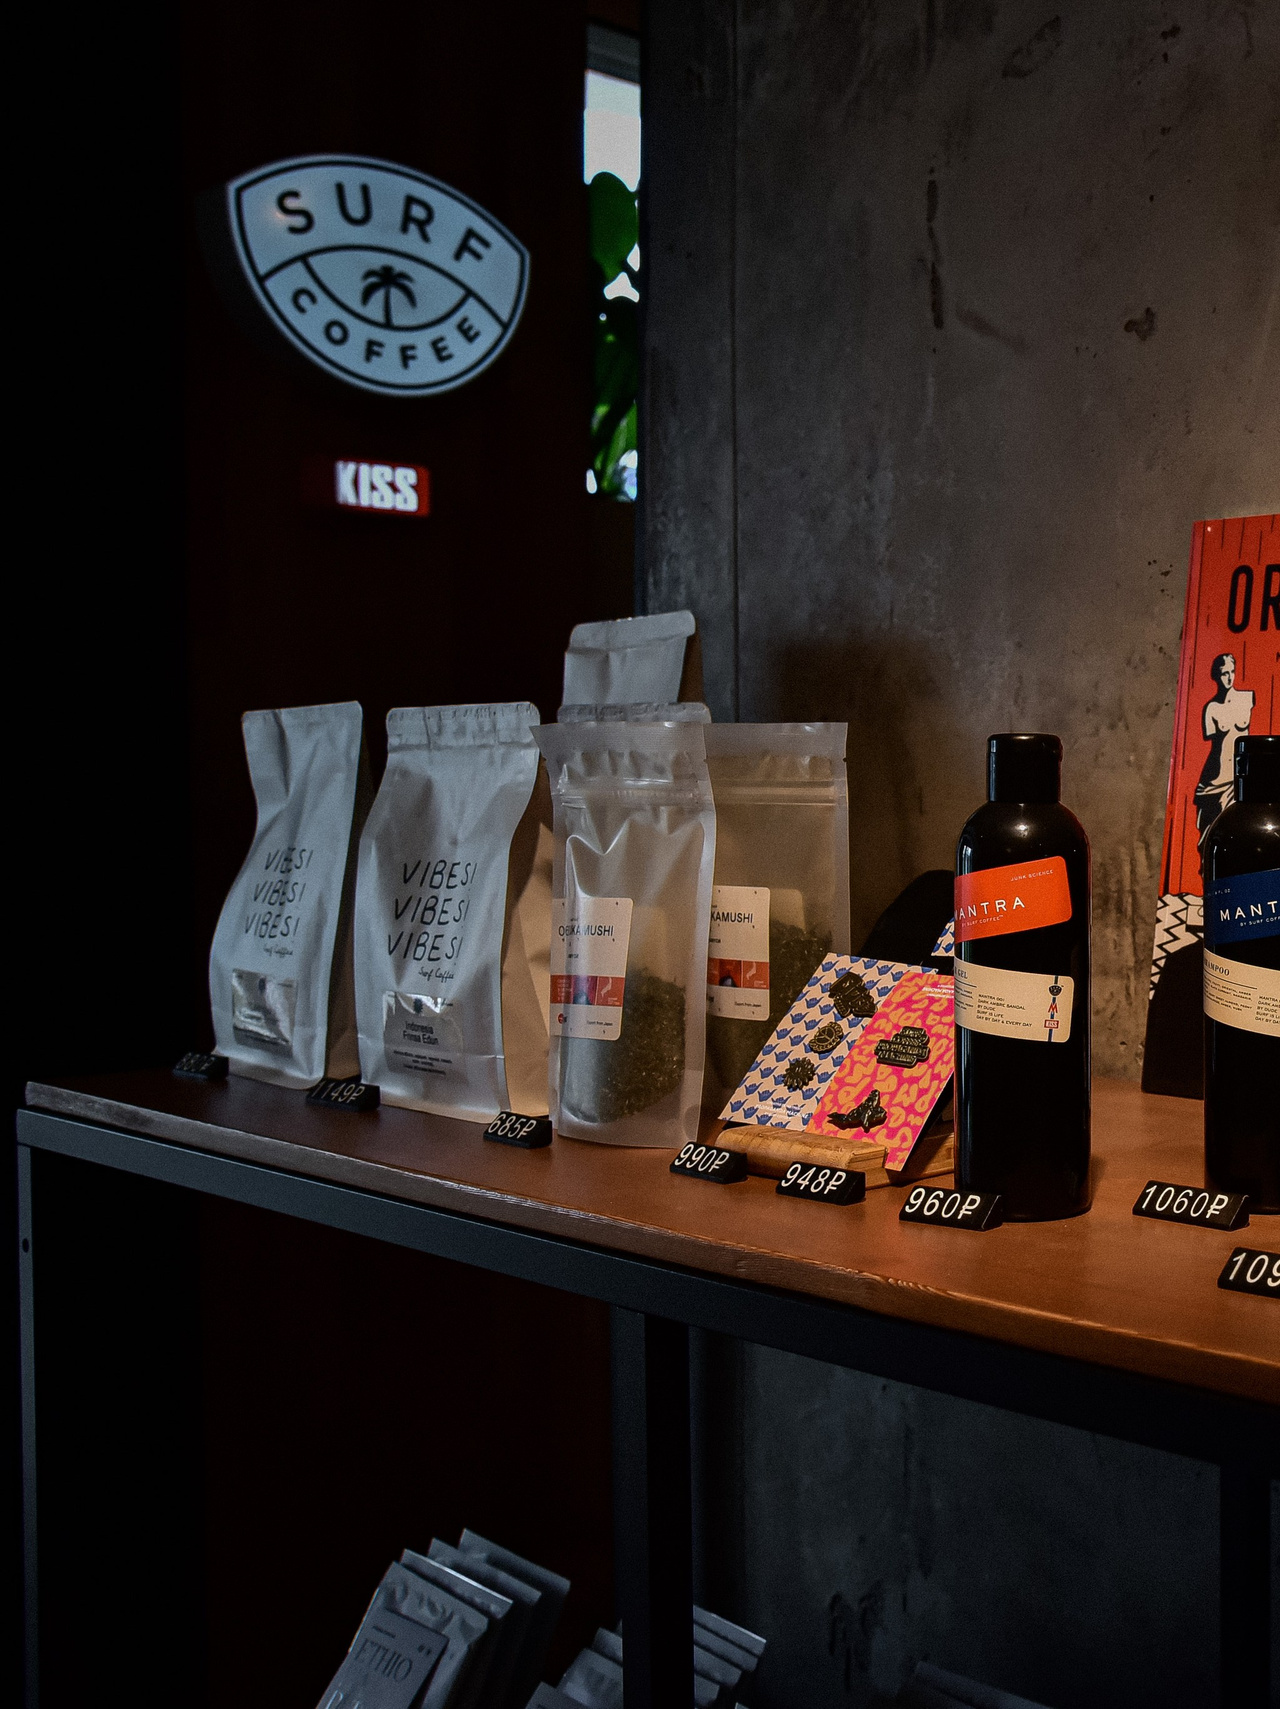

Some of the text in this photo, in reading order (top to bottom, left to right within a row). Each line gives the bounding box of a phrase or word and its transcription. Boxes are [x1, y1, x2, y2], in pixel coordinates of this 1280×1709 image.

[277, 182, 492, 262] SURF
[291, 287, 481, 369] COFFEE
[335, 459, 420, 513] KISS
